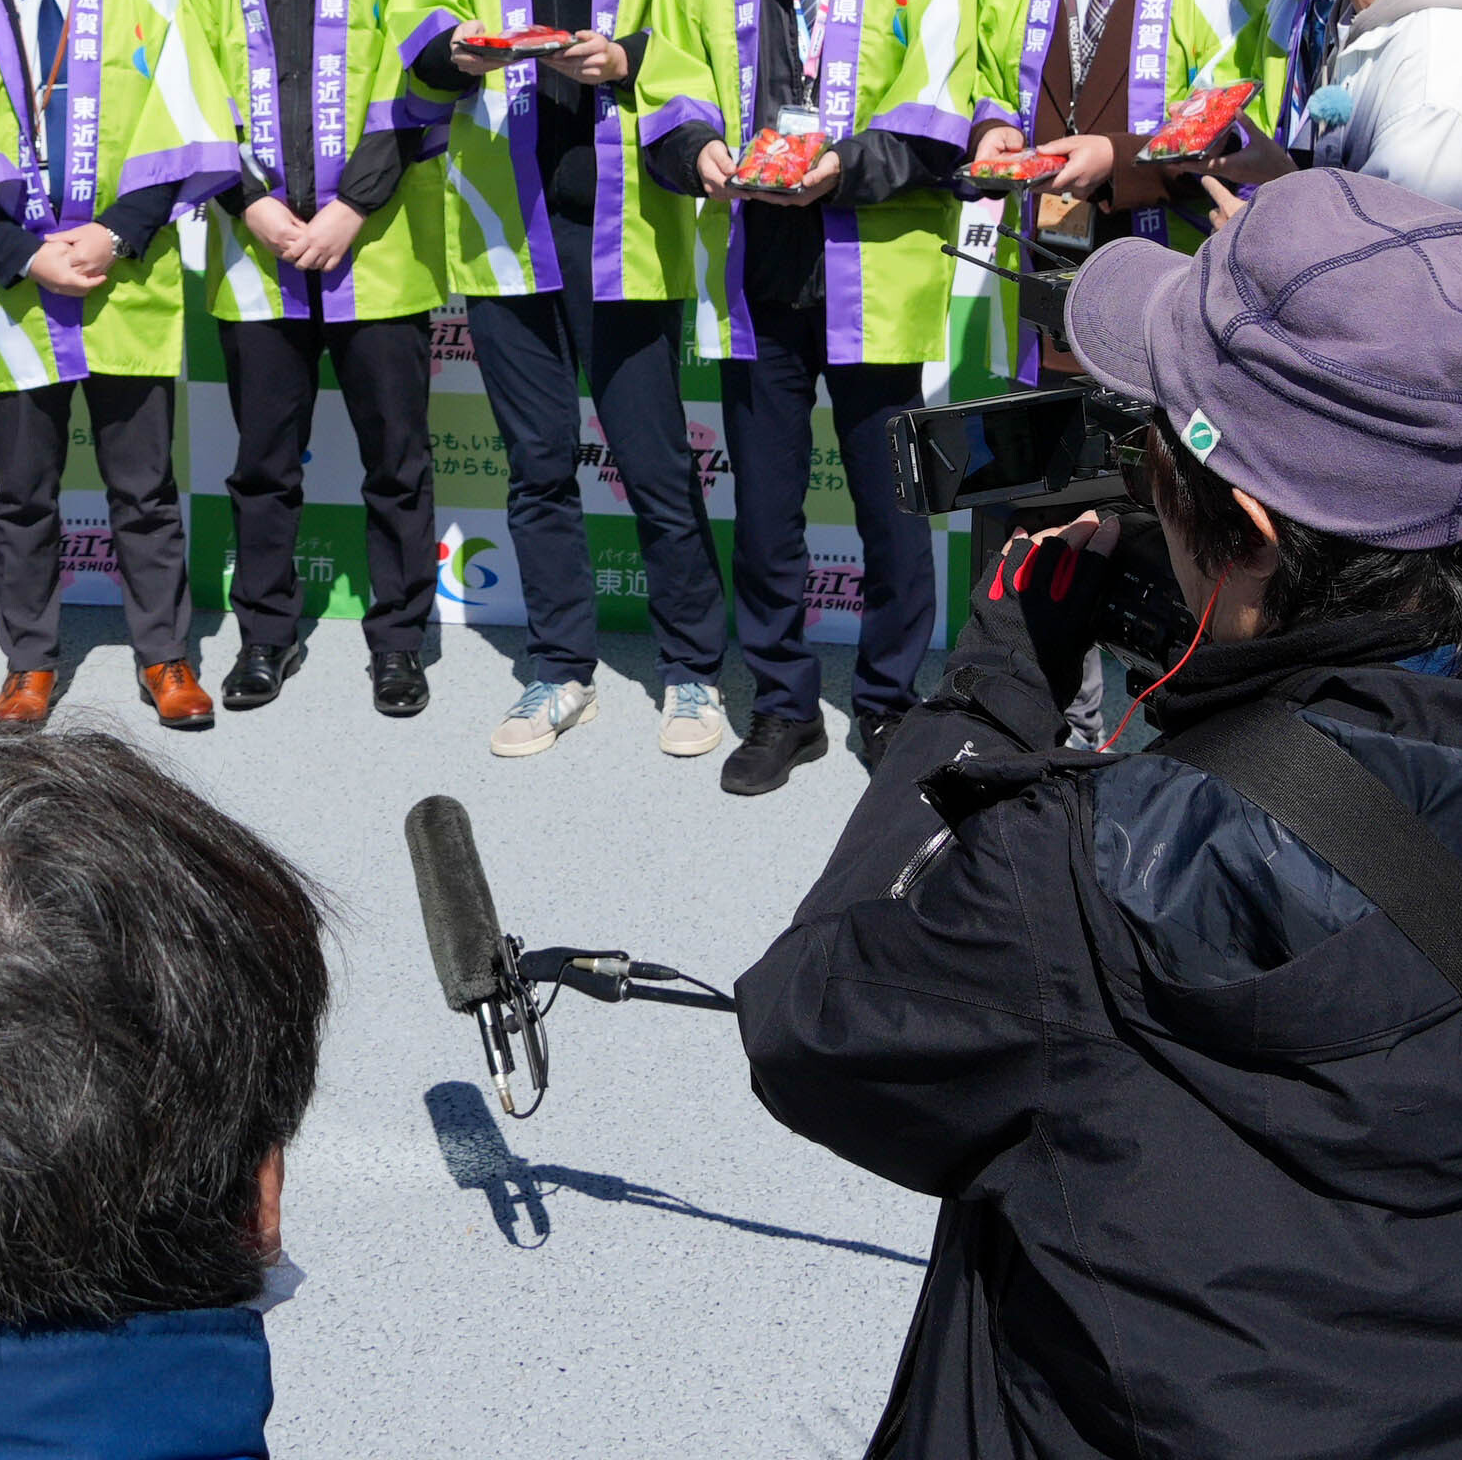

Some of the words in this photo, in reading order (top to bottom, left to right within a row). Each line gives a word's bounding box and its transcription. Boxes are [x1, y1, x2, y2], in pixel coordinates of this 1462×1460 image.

[70, 96, 96, 202] 東近江市
[251, 67, 276, 169] 東近江市
[317, 53, 343, 158] 東近江市
